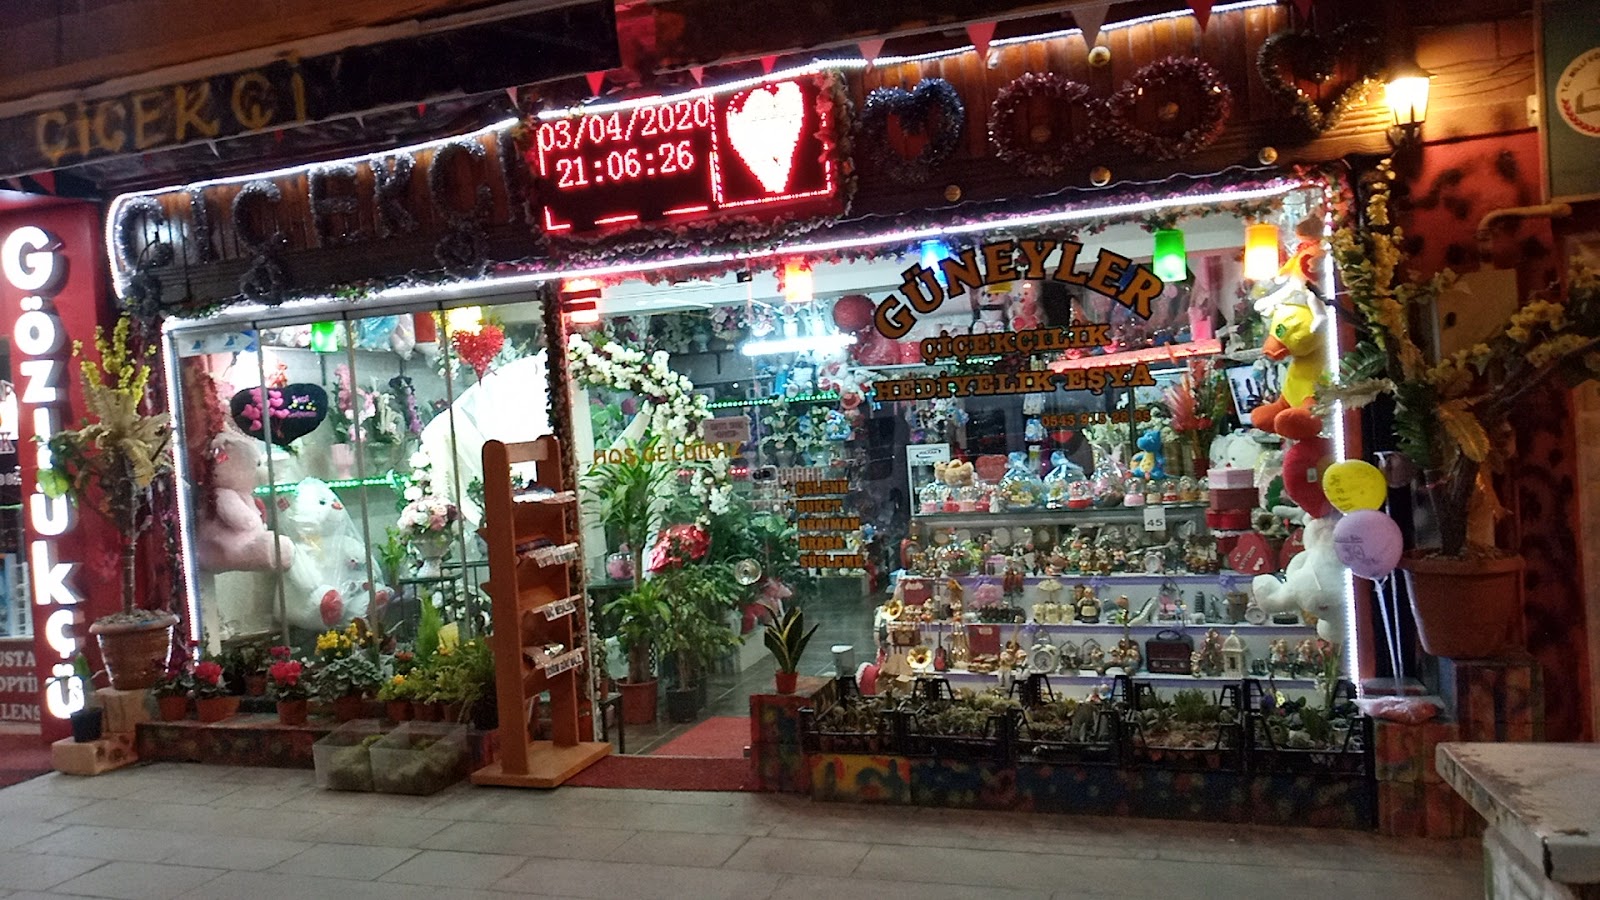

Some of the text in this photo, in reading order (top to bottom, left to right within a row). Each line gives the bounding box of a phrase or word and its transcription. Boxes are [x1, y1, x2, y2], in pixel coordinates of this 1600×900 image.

[539, 99, 710, 152] 03/04/2020
[556, 140, 695, 188] 21:06:26
[874, 239, 1163, 339] GÜNEYLER
[919, 320, 1112, 365] ÇİÇEKÇİLİK
[873, 364, 1156, 401] HEDİYELİK EŞYA
[796, 499, 843, 513] BUKET
[1146, 519, 1164, 527] 45
[798, 535, 845, 551] ARABA
